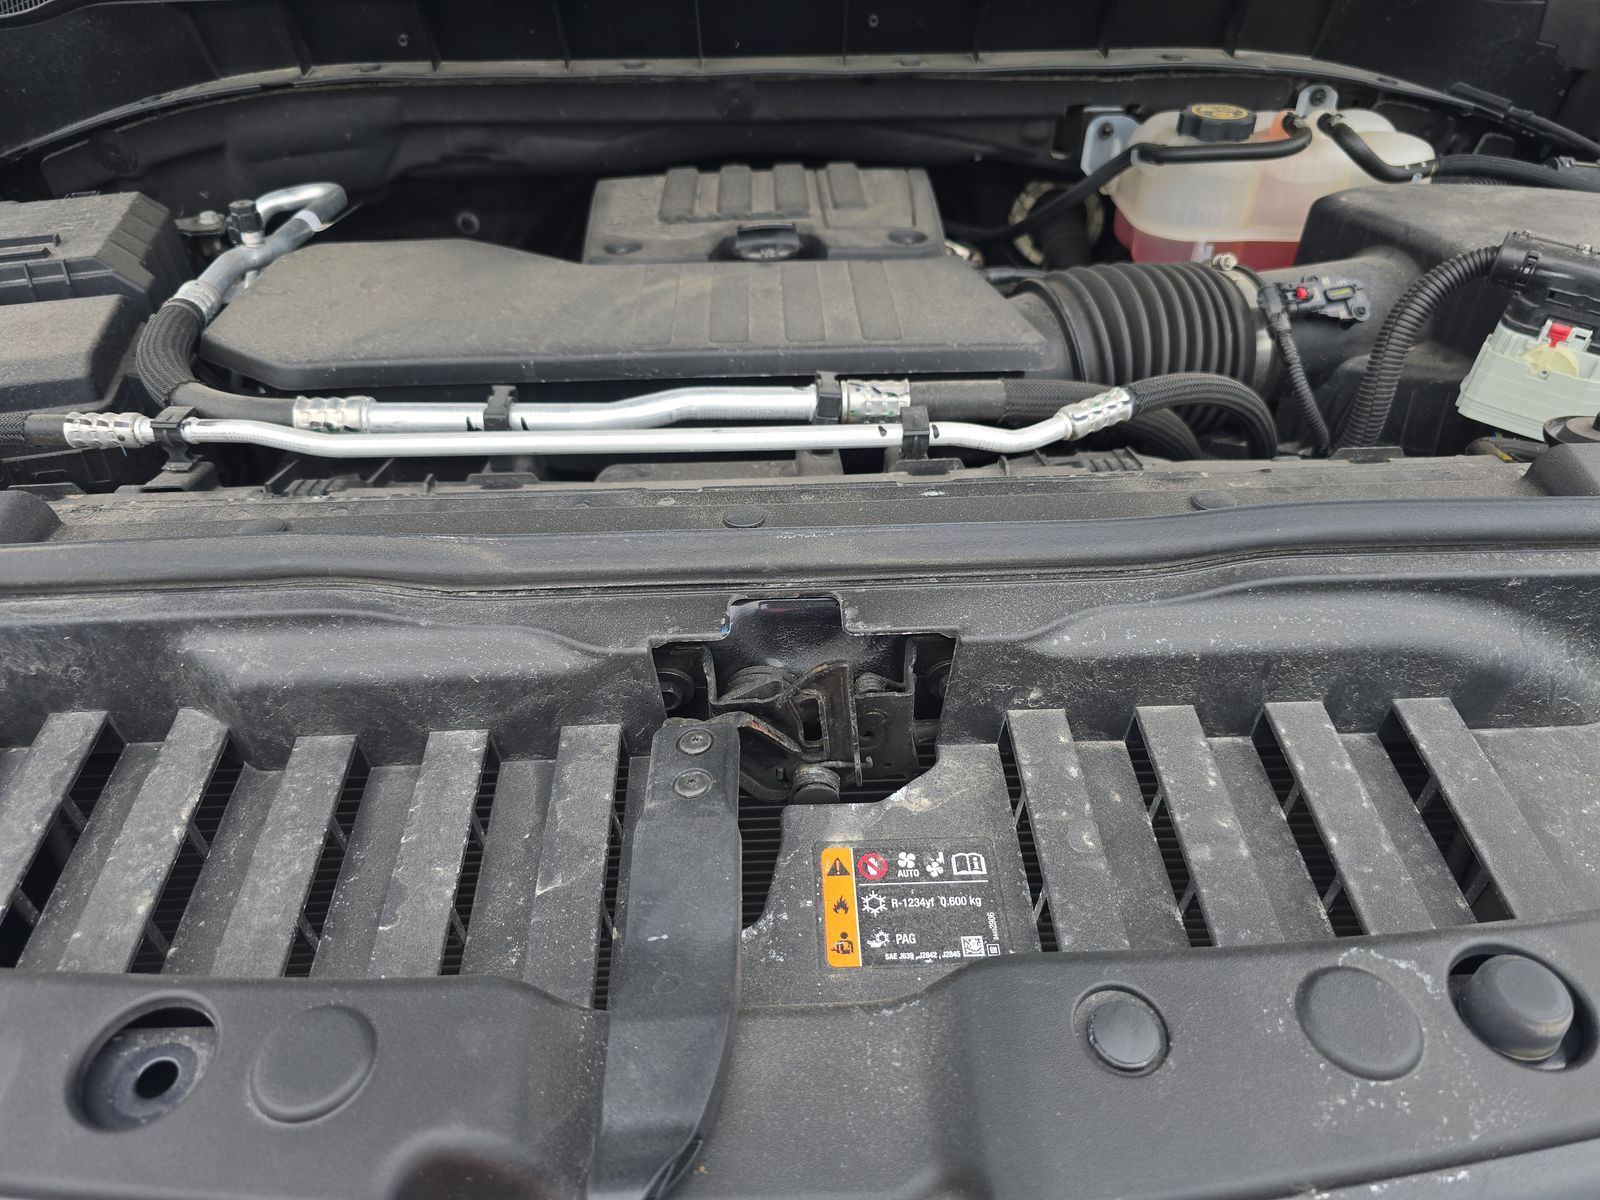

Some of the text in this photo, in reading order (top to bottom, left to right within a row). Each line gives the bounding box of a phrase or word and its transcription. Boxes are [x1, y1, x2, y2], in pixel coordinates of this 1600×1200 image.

[897, 869, 920, 878] AUTO
[891, 896, 982, 909] R-1234yf 0.600 kg
[895, 933, 917, 944] PAG
[885, 952, 898, 960] SAE
